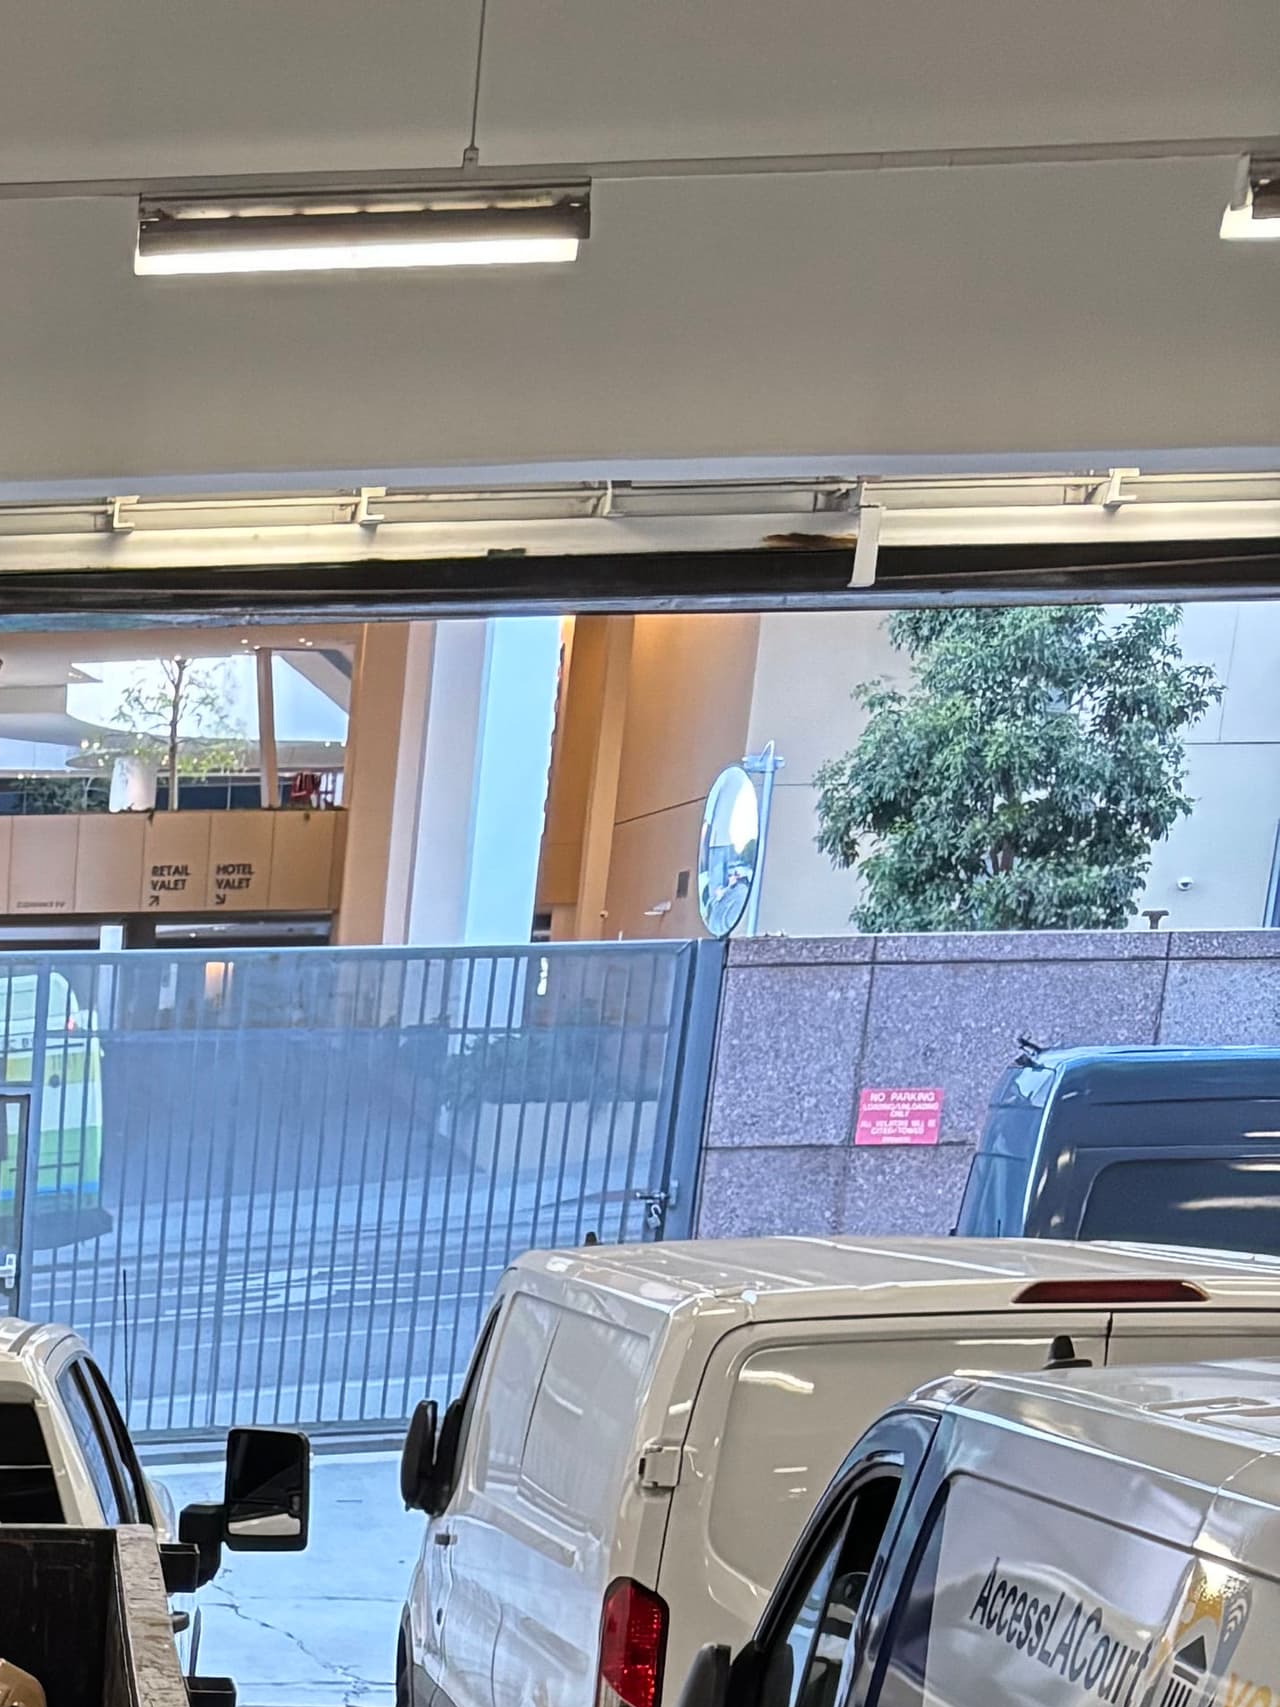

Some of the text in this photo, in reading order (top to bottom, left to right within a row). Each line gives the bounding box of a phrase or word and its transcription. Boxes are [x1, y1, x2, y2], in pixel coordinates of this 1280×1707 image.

[152, 864, 191, 877] RETAIL
[216, 863, 254, 875] HOTEL
[151, 878, 186, 891] VALET
[216, 878, 251, 890] VALET
[870, 1091, 935, 1102] NO PARKING
